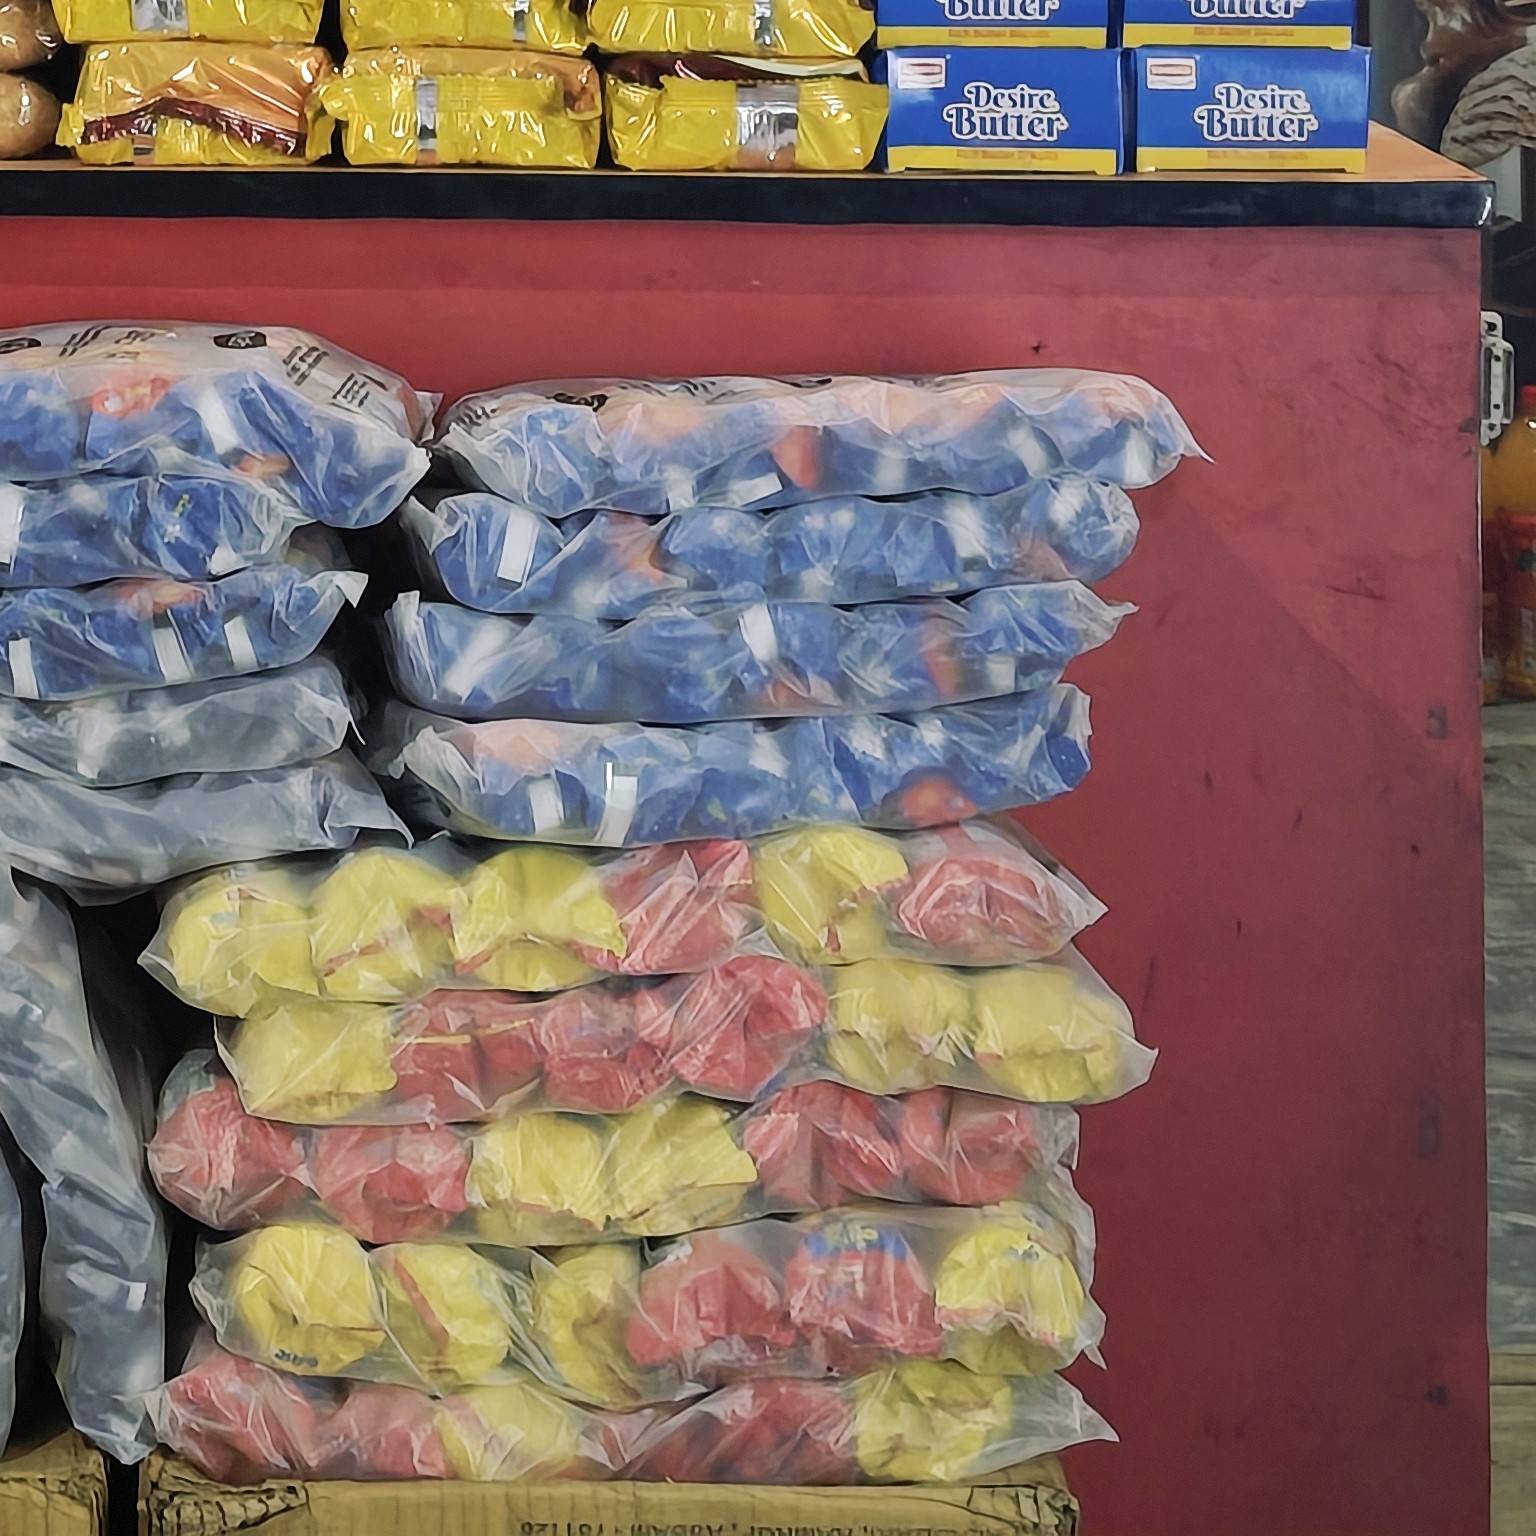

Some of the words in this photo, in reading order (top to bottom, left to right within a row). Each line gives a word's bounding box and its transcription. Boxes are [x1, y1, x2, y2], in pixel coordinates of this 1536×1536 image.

[963, 81, 1061, 110] Desire
[1214, 81, 1311, 113] Desire
[942, 102, 1069, 142] Butter
[1193, 103, 1320, 142] Butter
